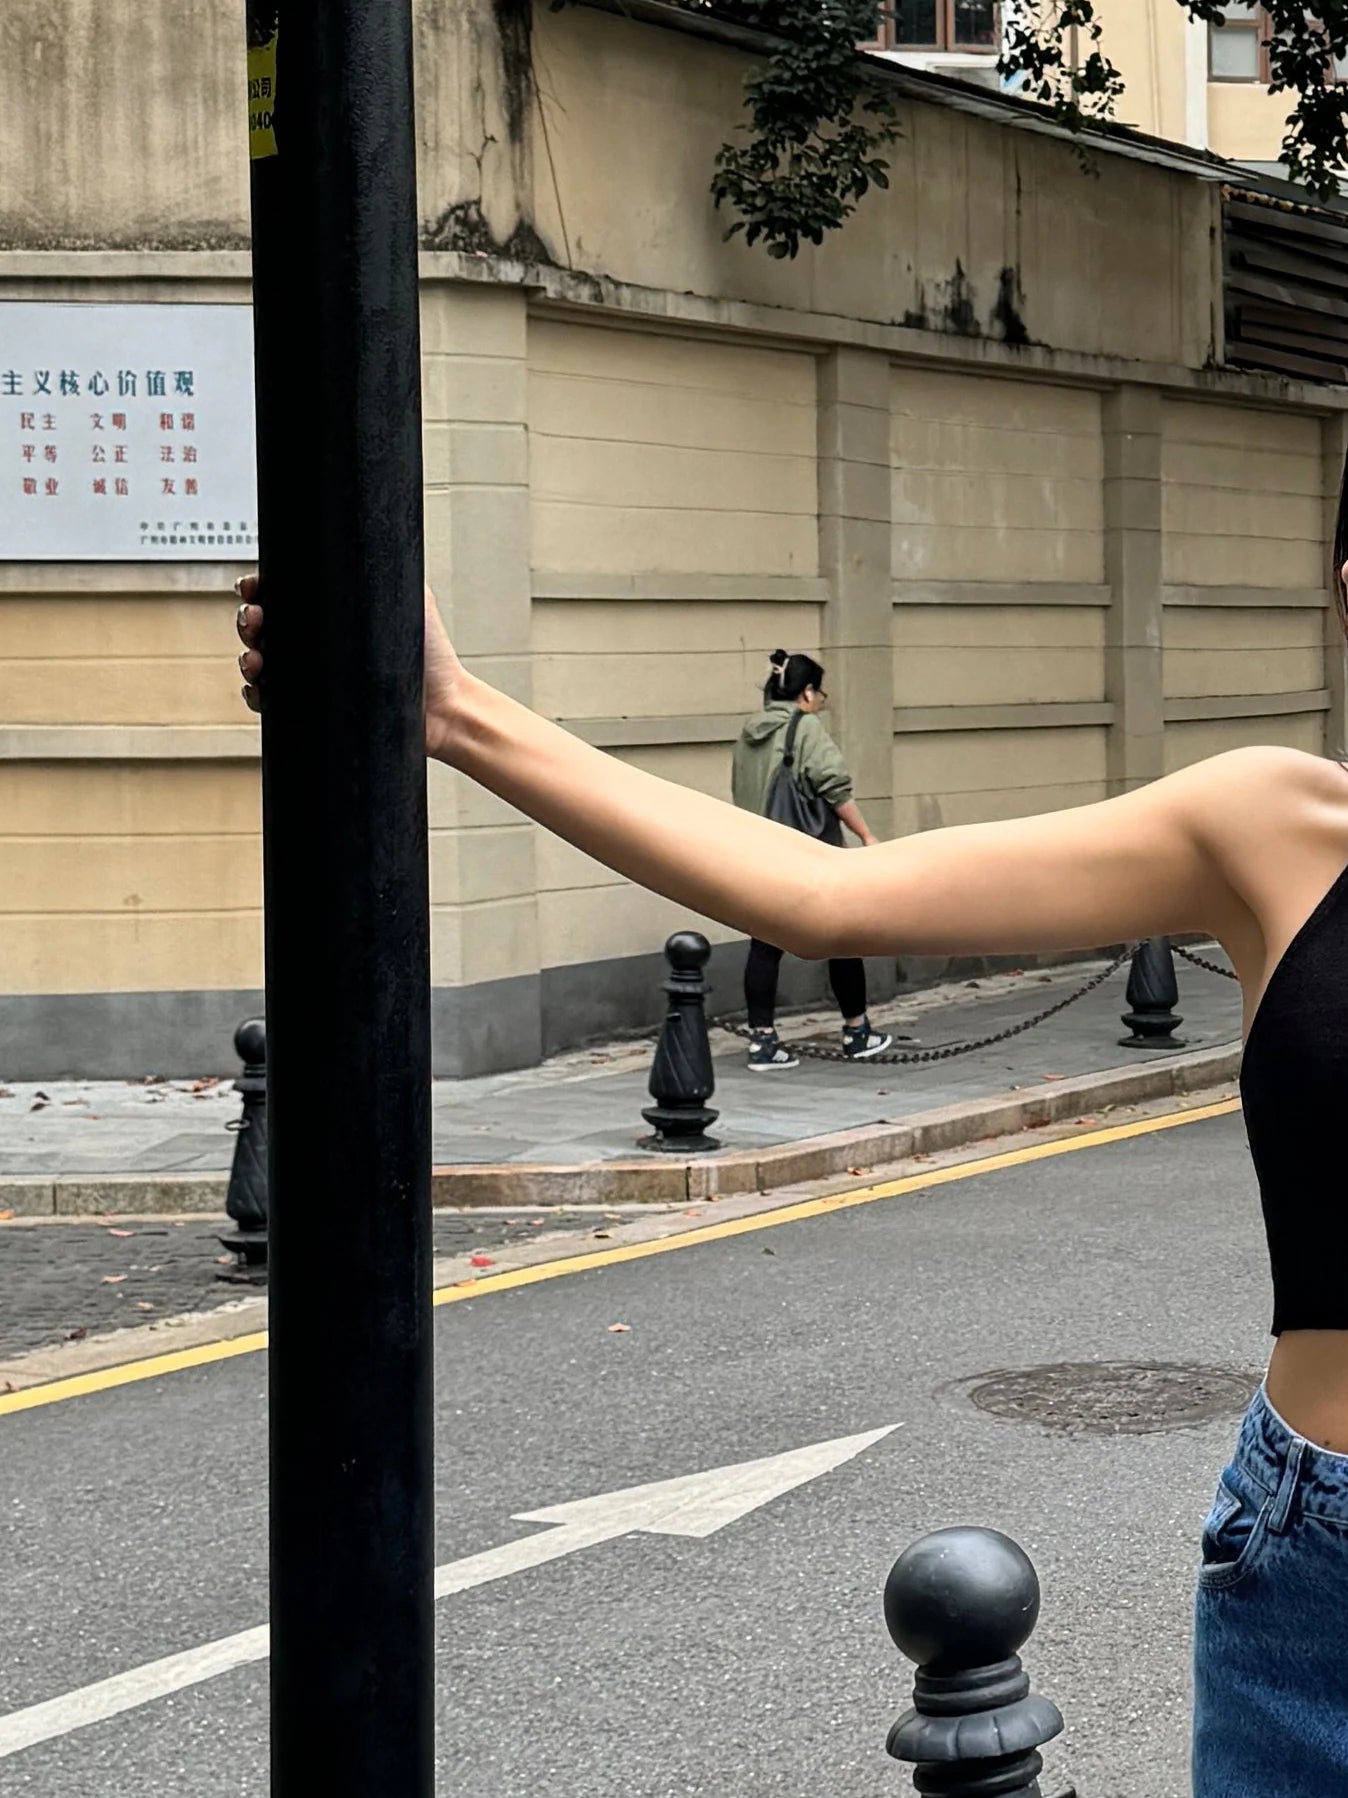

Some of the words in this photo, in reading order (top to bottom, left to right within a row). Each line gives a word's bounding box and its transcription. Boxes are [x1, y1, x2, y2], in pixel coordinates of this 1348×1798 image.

[1, 370, 195, 396] 主义核心价值观
[20, 412, 57, 430] 民主
[90, 412, 127, 431] 文明
[92, 444, 128, 463] 公正
